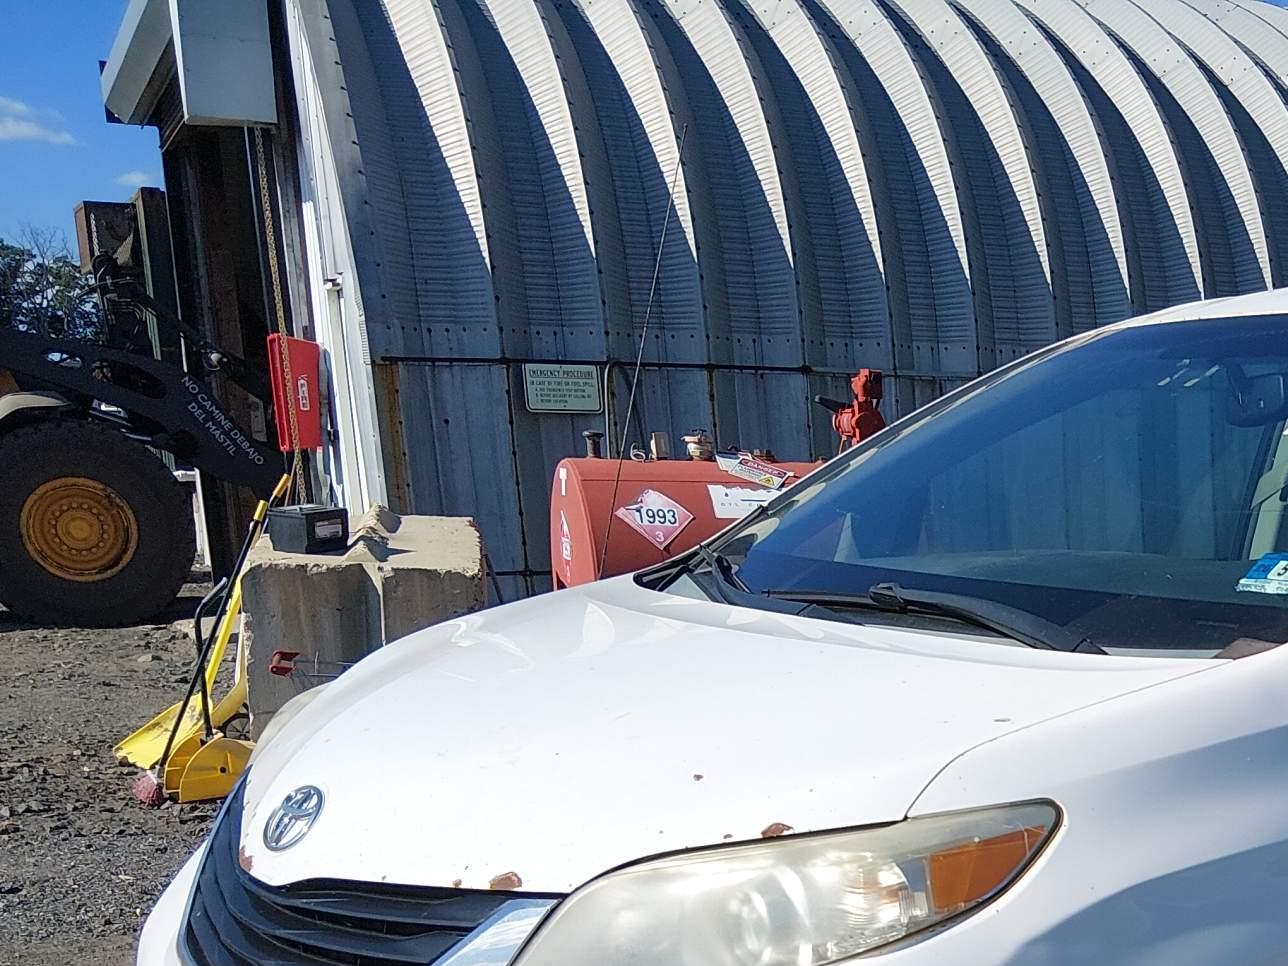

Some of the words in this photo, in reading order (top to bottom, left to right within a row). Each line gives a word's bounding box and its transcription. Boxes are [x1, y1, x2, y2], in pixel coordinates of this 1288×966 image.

[529, 369, 560, 378] EMERGENCY
[562, 370, 594, 379] PROCEDURE
[182, 376, 199, 394] NO
[198, 394, 234, 431] CAMINE
[230, 429, 264, 465] DEBAJO
[187, 402, 206, 423] DEL
[748, 461, 779, 476] DANGER
[636, 508, 677, 525] 1993
[655, 531, 665, 542] 3
